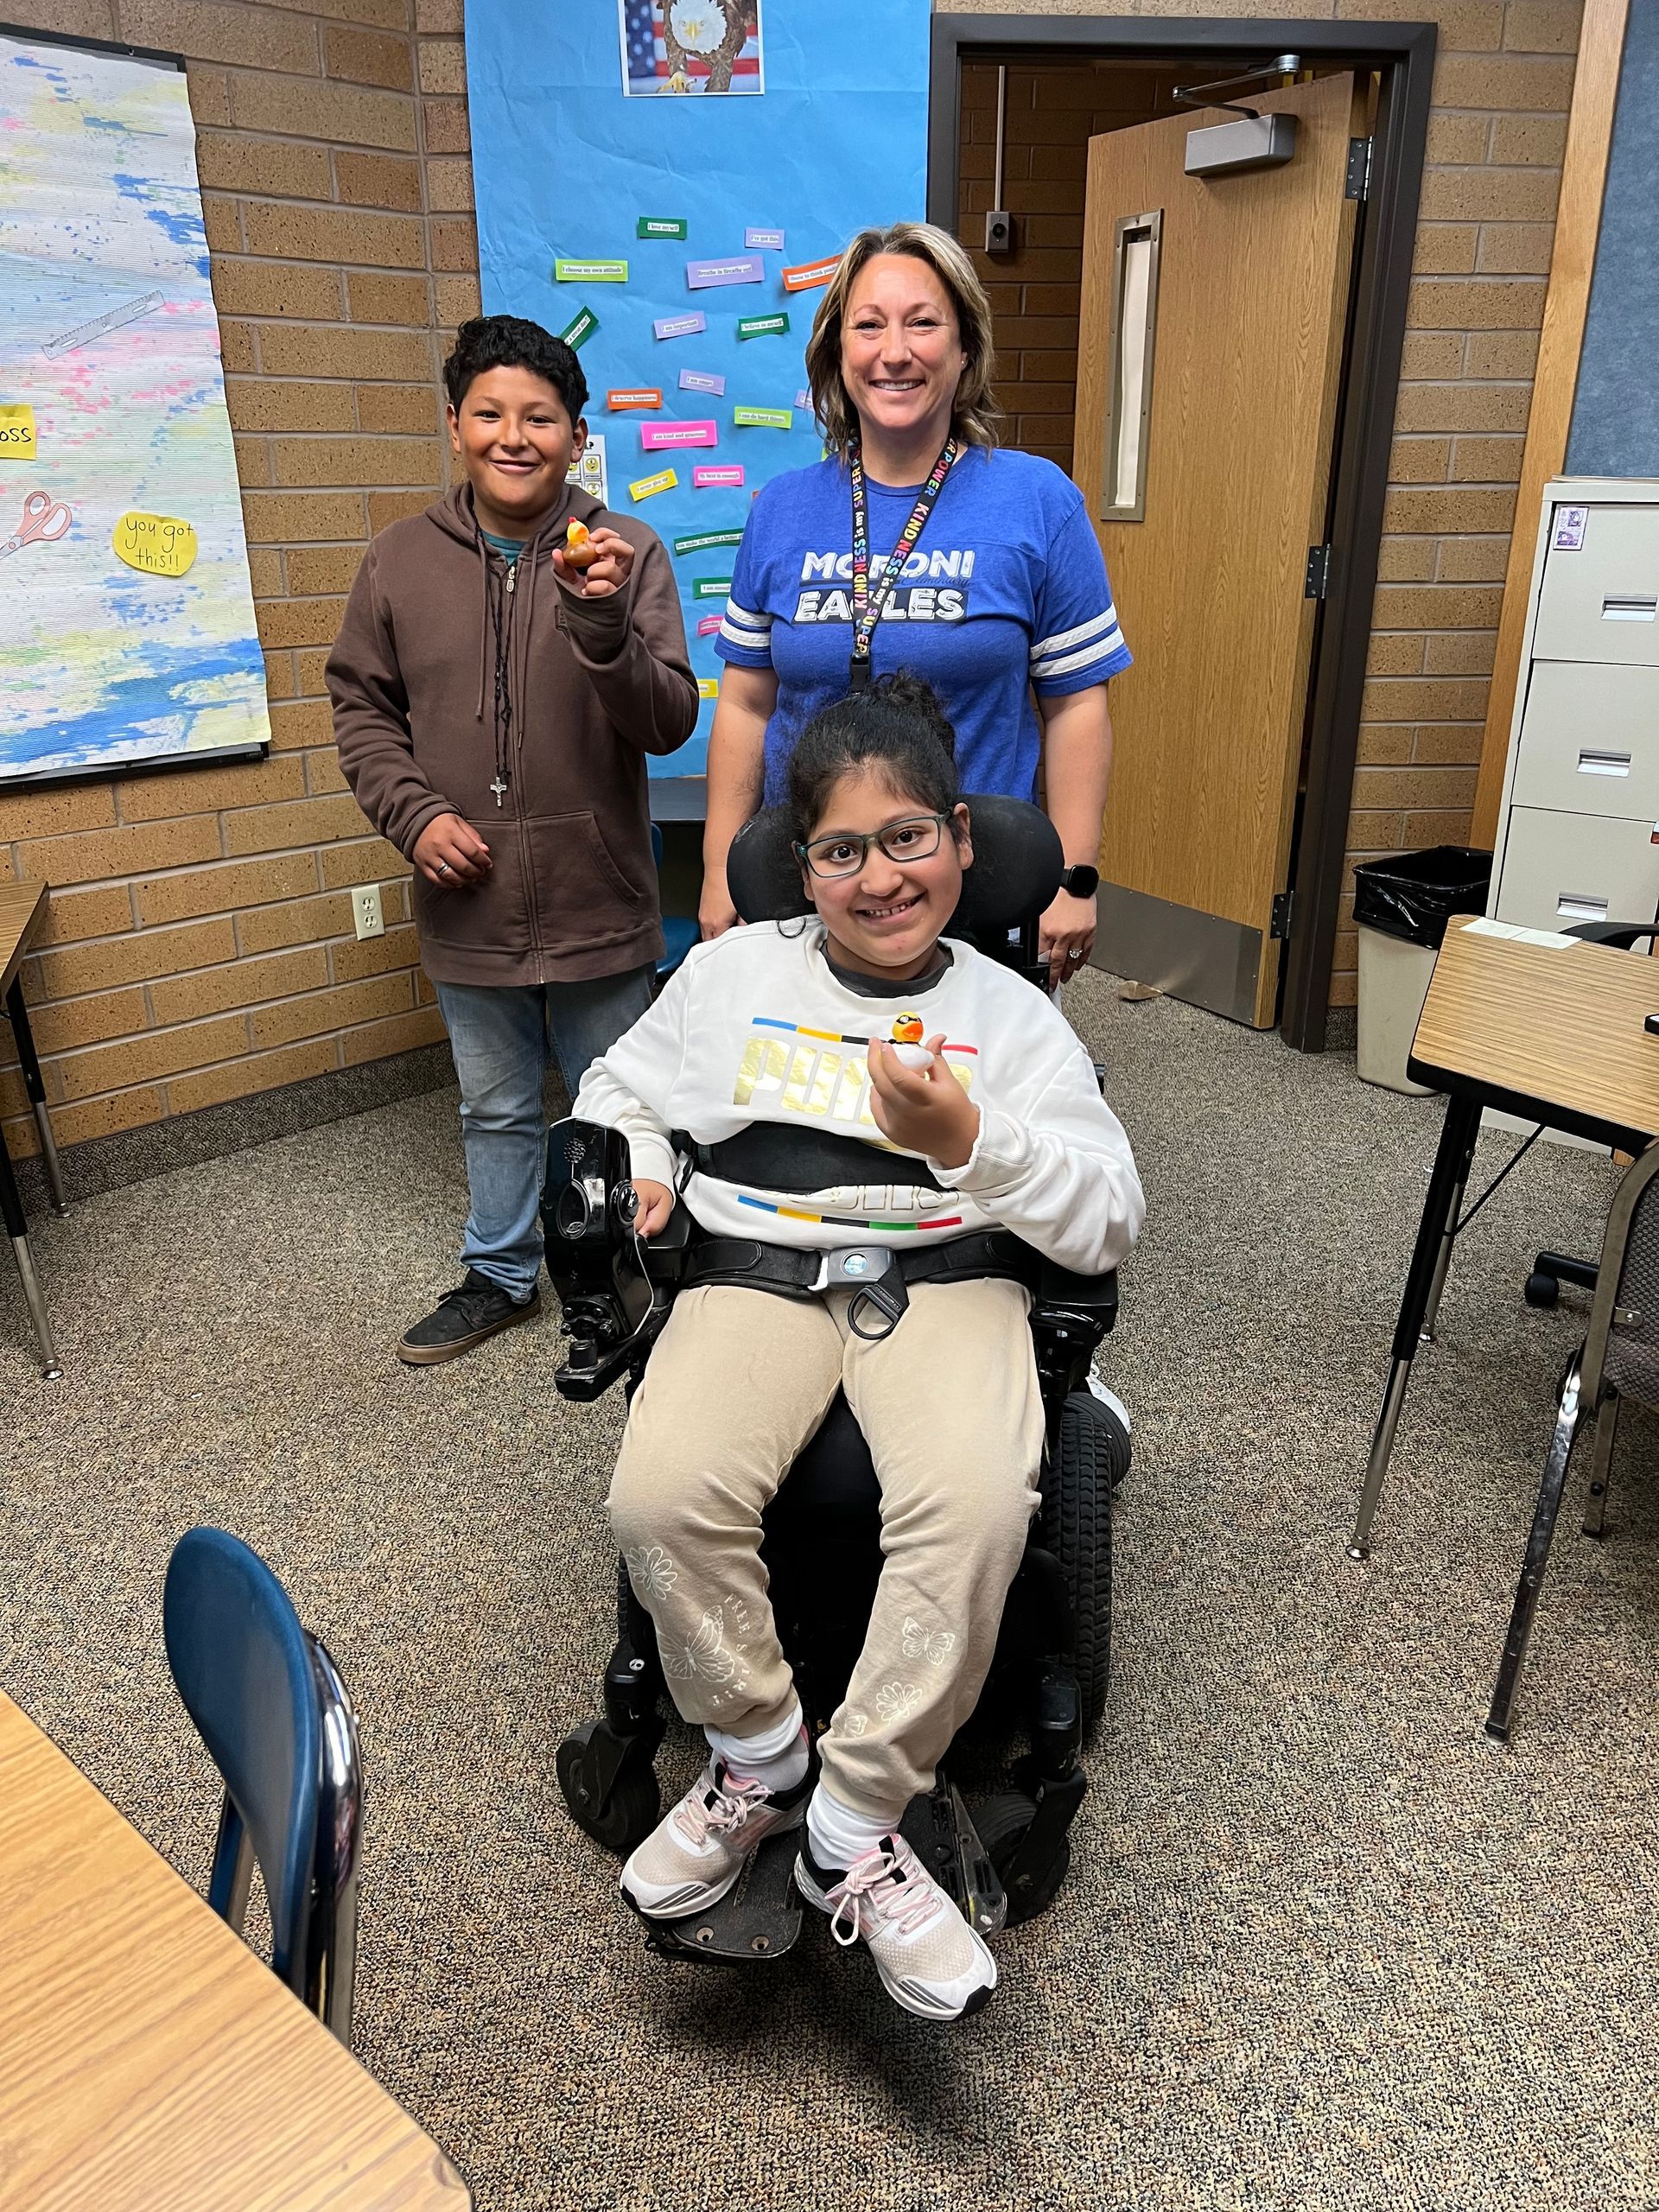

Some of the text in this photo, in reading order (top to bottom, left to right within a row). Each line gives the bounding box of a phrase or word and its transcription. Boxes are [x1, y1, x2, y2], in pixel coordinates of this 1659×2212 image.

[851, 467, 864, 508] SUPER
[925, 452, 953, 497] POWER
[124, 518, 194, 553] you got
[854, 526, 865, 538] is
[855, 512, 865, 527] my
[886, 502, 930, 575] KINDNESS
[136, 547, 180, 571] this!!
[854, 538, 868, 609] KINDNESS
[872, 588, 887, 605] my
[881, 576, 894, 587] is
[793, 588, 965, 621] EALES
[733, 1036, 973, 1125] PU
[723, 1592, 750, 1635] FREE
[712, 1643, 751, 1707] SIRIT
